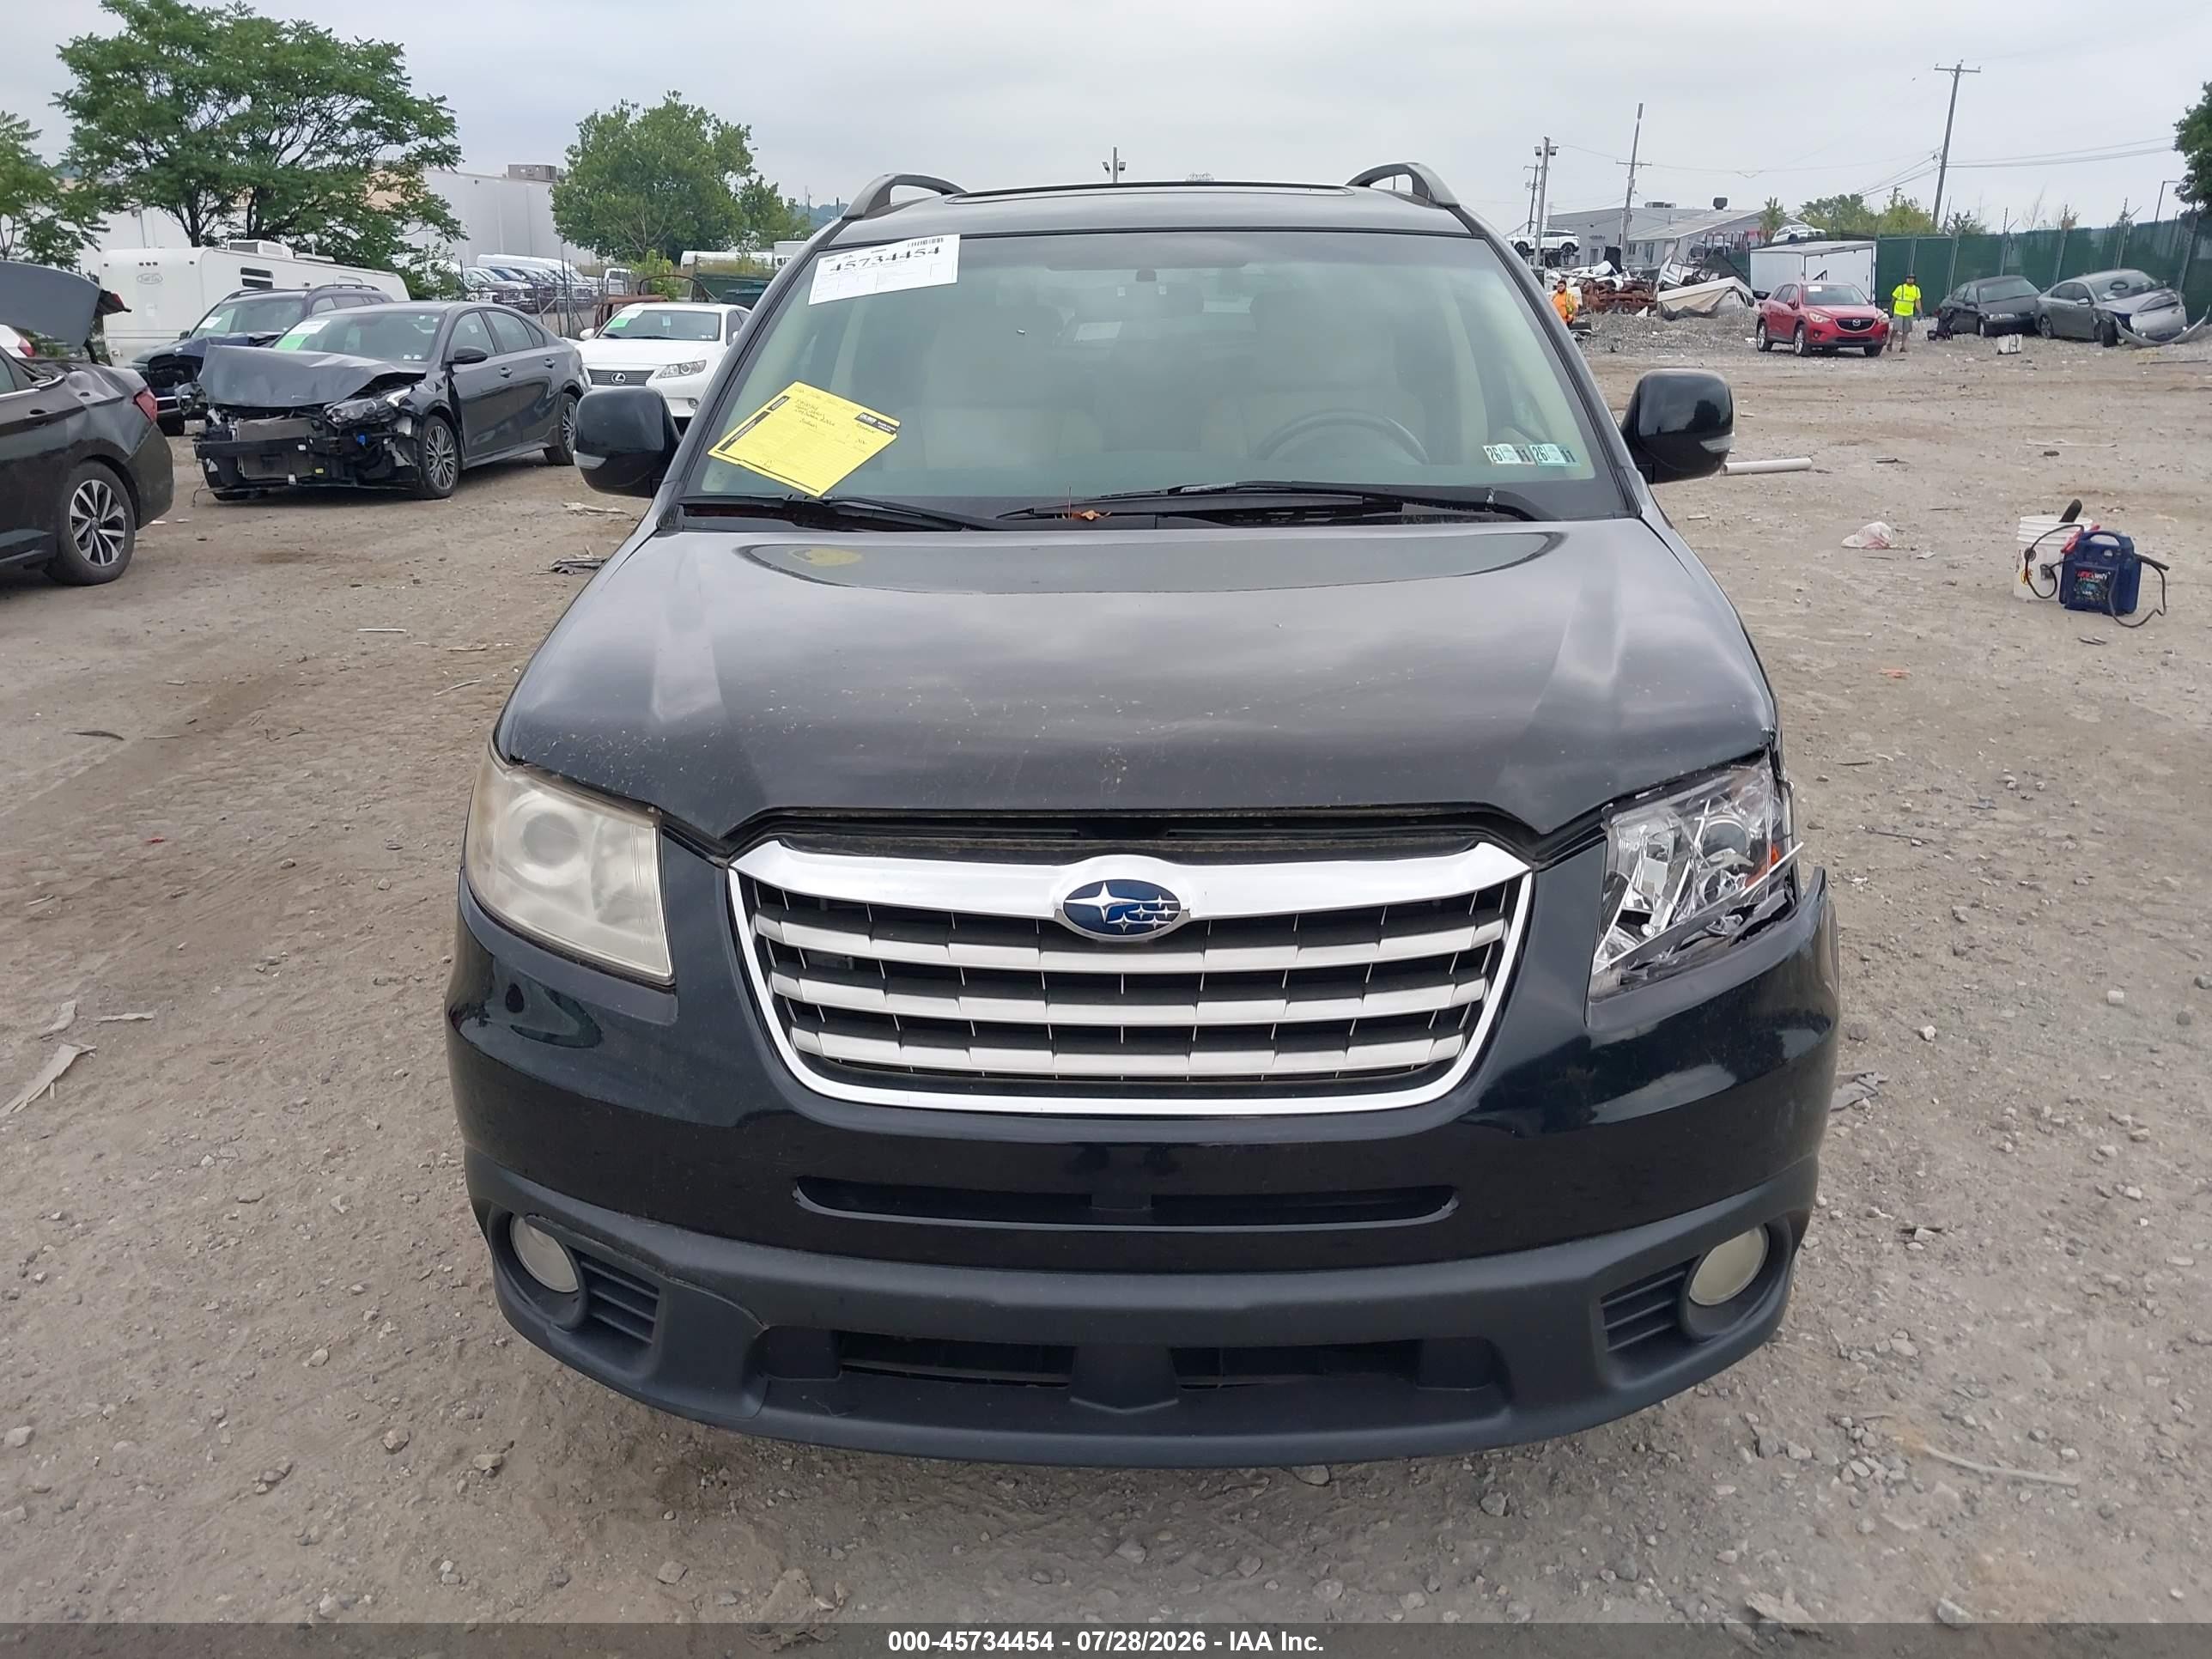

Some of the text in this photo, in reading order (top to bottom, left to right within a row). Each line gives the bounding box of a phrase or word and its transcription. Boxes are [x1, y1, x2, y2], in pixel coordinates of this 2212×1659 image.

[830, 246, 940, 272] 45734454
[1486, 447, 1531, 463] 26 11
[1532, 447, 1577, 463] 26 11
